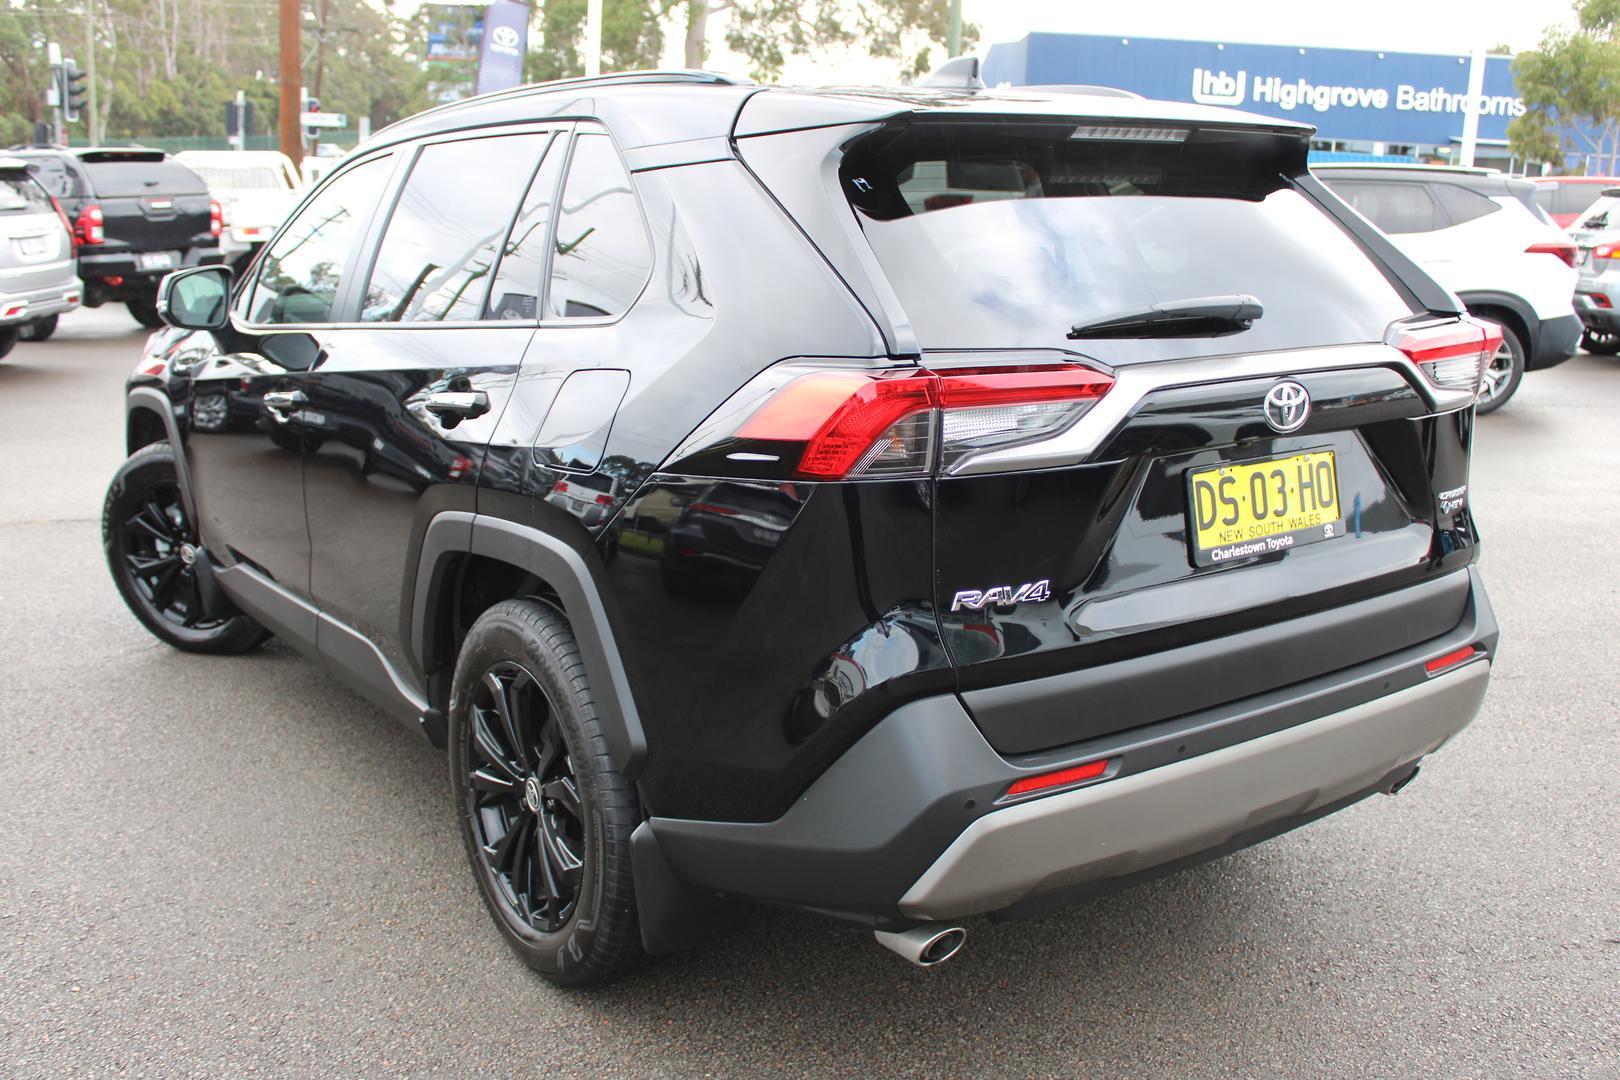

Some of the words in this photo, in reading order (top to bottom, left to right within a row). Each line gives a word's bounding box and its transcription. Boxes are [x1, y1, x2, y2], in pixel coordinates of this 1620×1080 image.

[1253, 76, 1389, 112] Highgrove
[1219, 529, 1244, 543] NEW
[1249, 521, 1284, 537] SOUTH
[1288, 513, 1322, 528] WALES
[1211, 541, 1266, 561] Charlestown
[1266, 535, 1294, 551] Toyota
[951, 579, 1050, 611] RAV4
